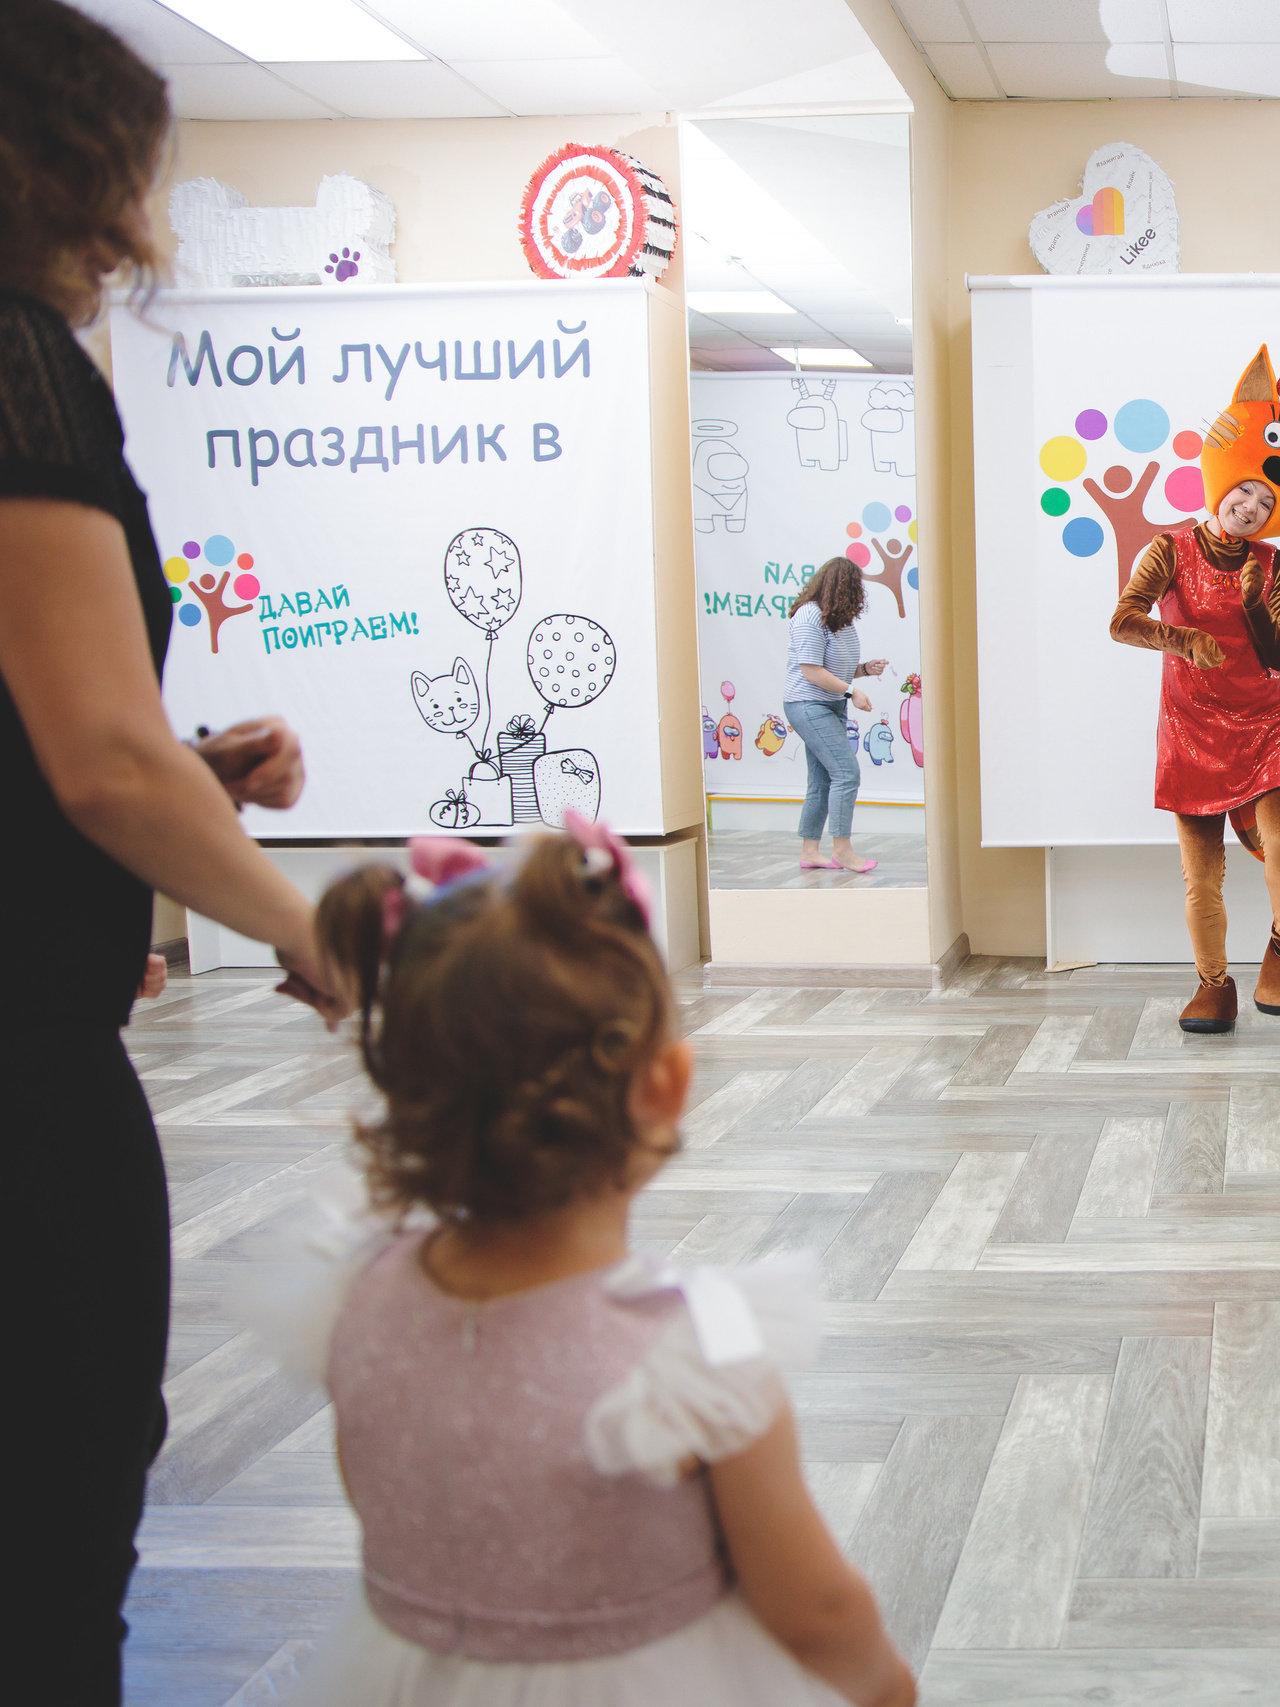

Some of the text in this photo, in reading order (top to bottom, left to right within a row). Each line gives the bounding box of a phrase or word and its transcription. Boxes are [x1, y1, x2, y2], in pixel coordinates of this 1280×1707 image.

[1095, 151, 1125, 168] #зажигай
[1126, 170, 1136, 189] #лайк
[1047, 202, 1070, 219] #танцуй
[1048, 233, 1061, 252] #party
[1077, 243, 1090, 275] вечеринка
[1119, 228, 1156, 265] Likee
[166, 319, 592, 402] Мой лучший
[206, 422, 563, 486] праздник в
[258, 584, 350, 622] ДАВАЙ
[262, 611, 419, 654] ПОИГРАЕМ!
